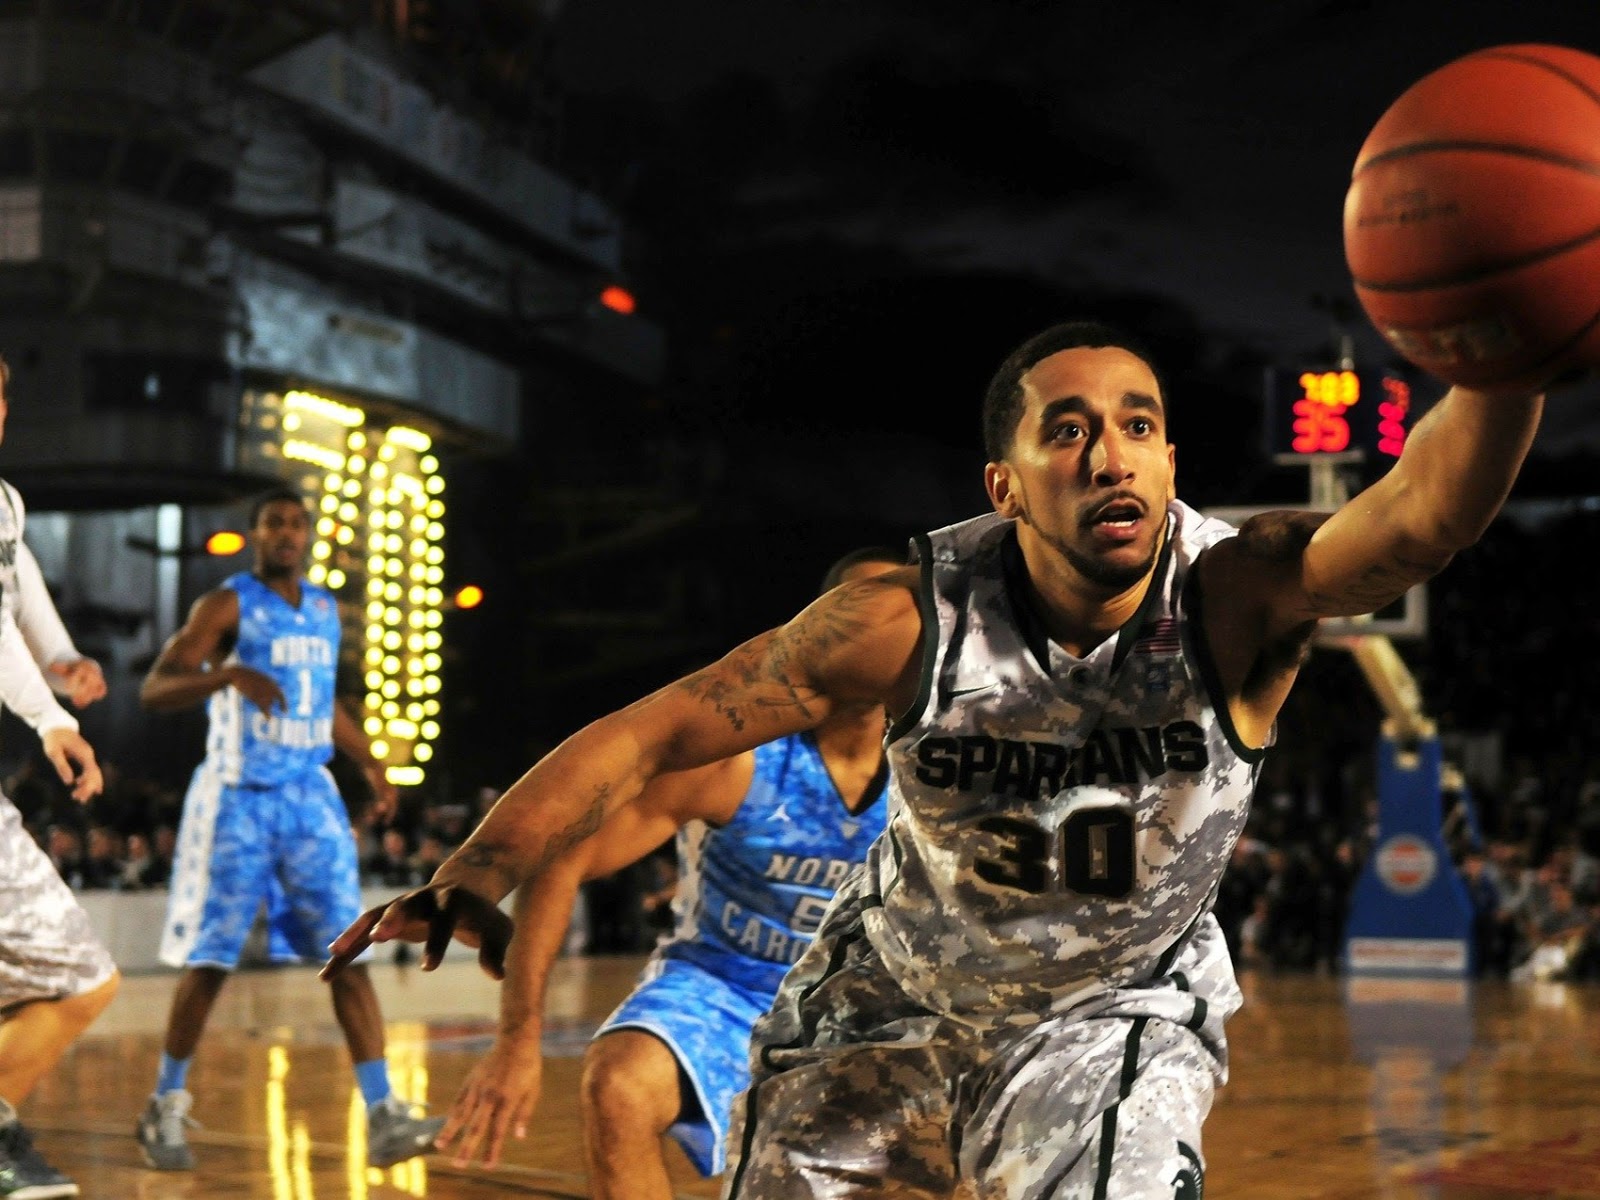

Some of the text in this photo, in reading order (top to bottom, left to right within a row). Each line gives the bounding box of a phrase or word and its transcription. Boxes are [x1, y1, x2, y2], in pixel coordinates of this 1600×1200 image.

[297, 668, 312, 717] 1
[764, 853, 867, 890] NOR
[972, 806, 1138, 897] 30
